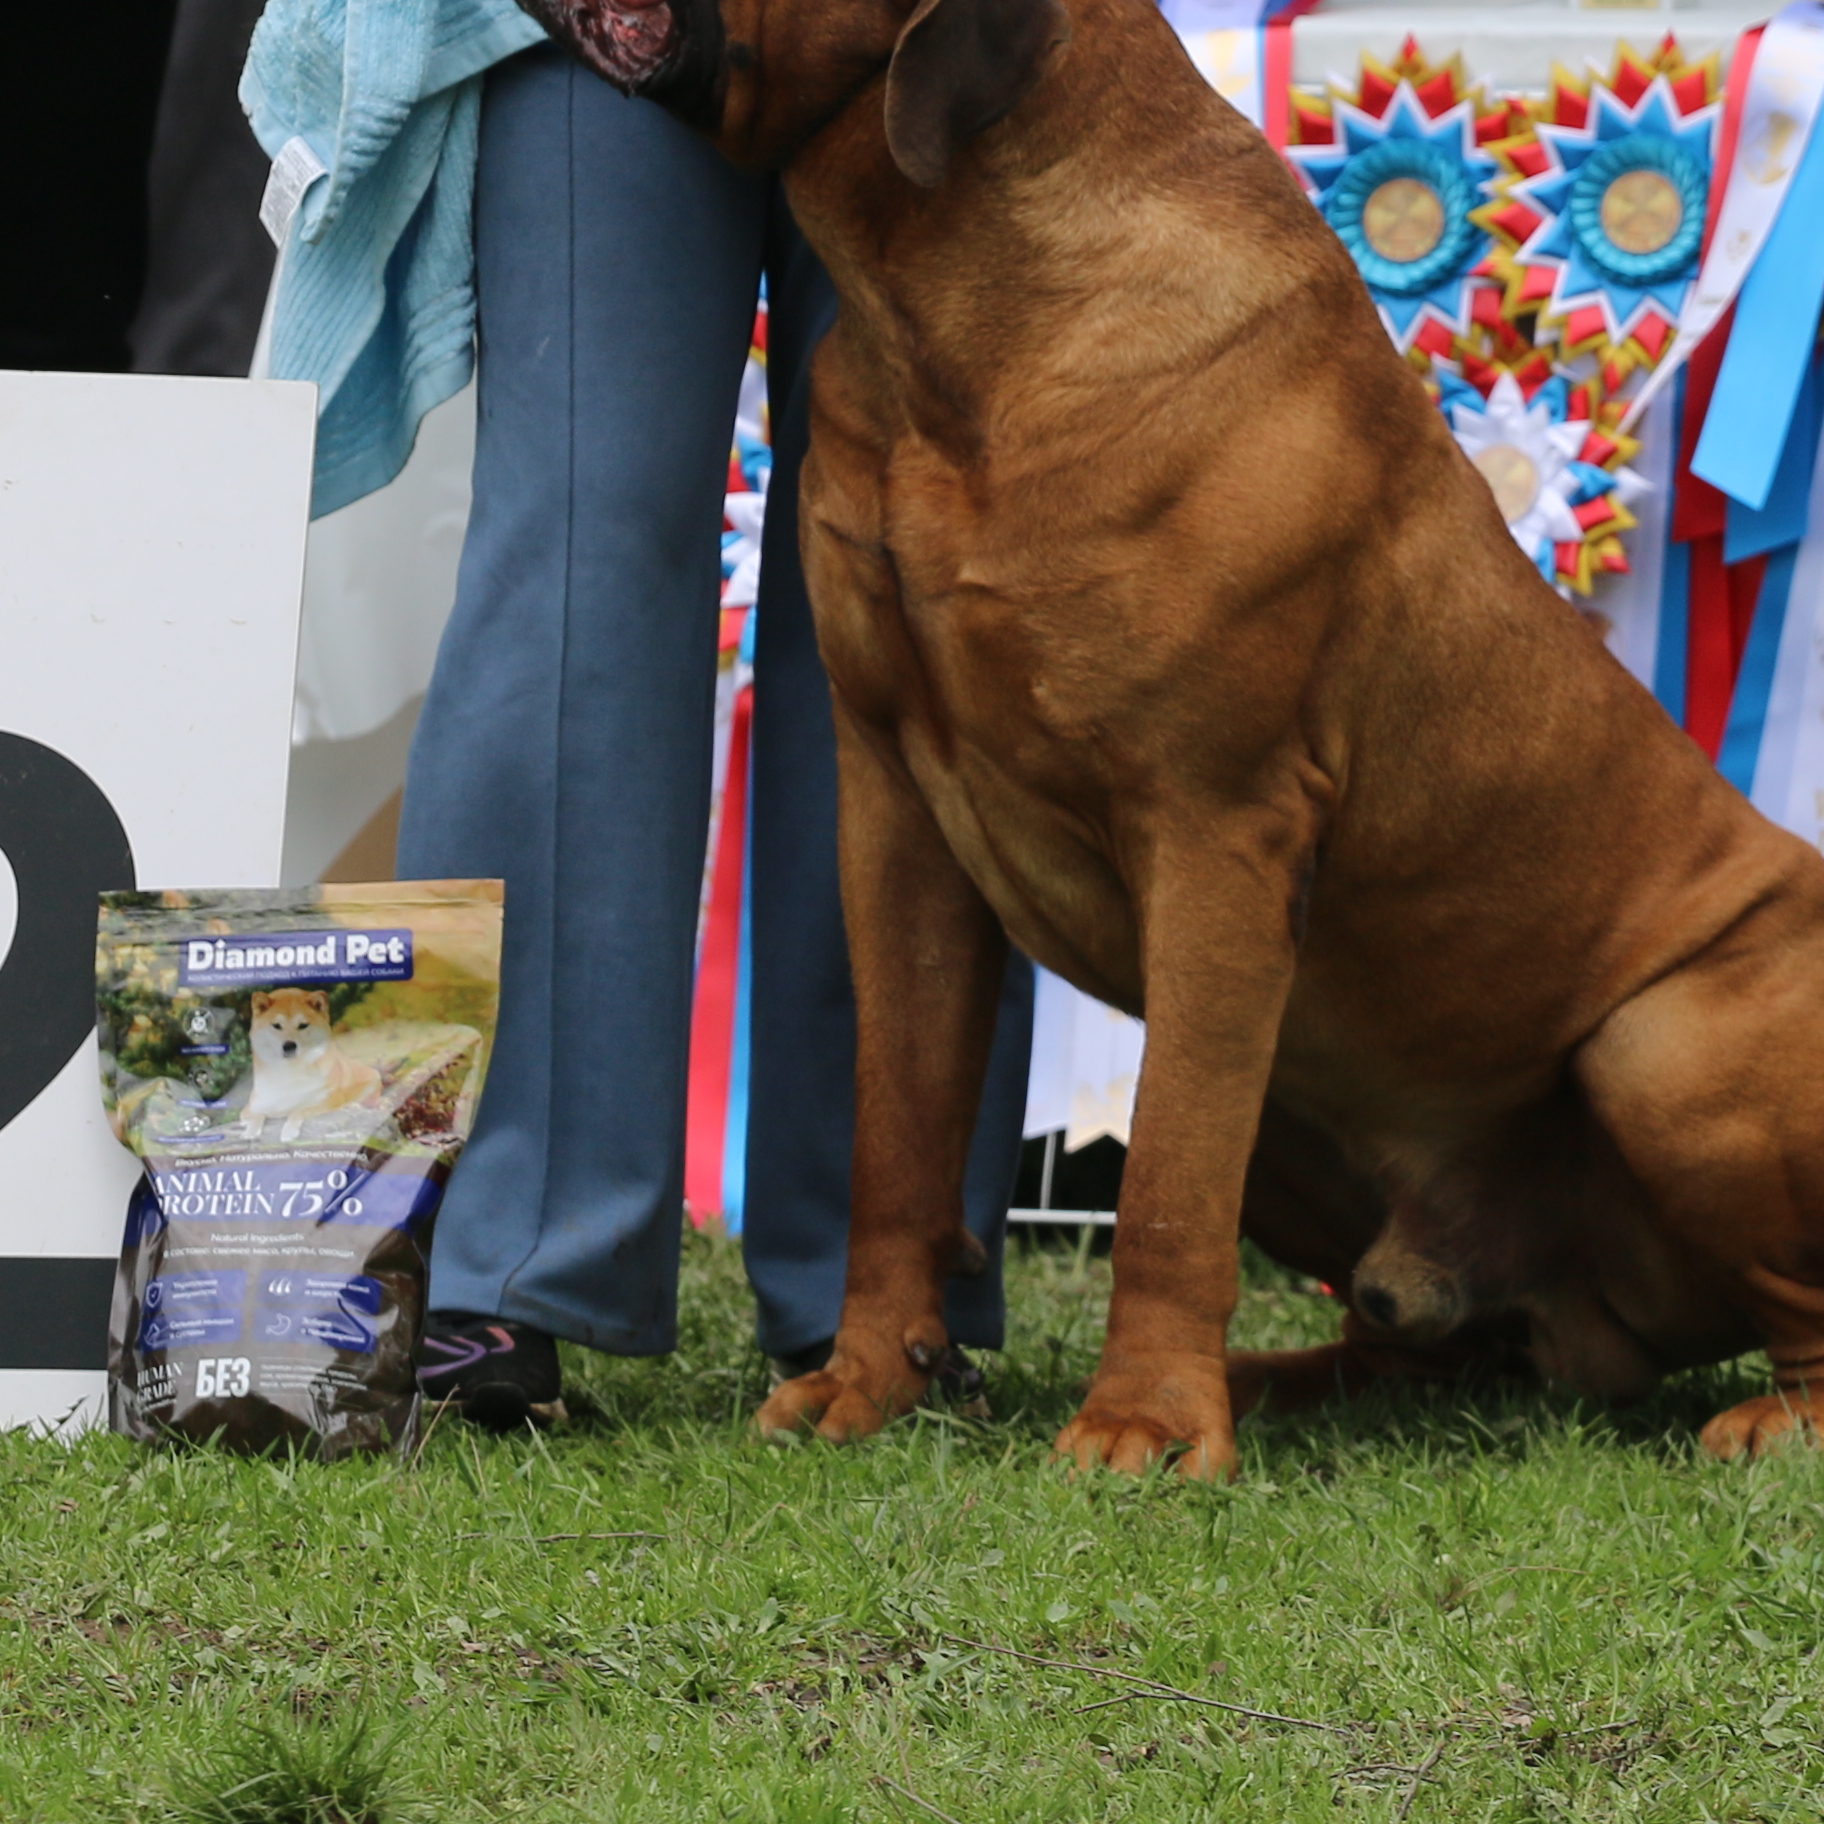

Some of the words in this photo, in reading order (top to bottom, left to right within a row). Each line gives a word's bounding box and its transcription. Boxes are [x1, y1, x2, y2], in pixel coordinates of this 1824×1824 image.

[187, 935, 337, 971] Diamond
[346, 934, 405, 965] Pet
[279, 1169, 363, 1217] 75%
[195, 1357, 251, 1398] БЕЗ
